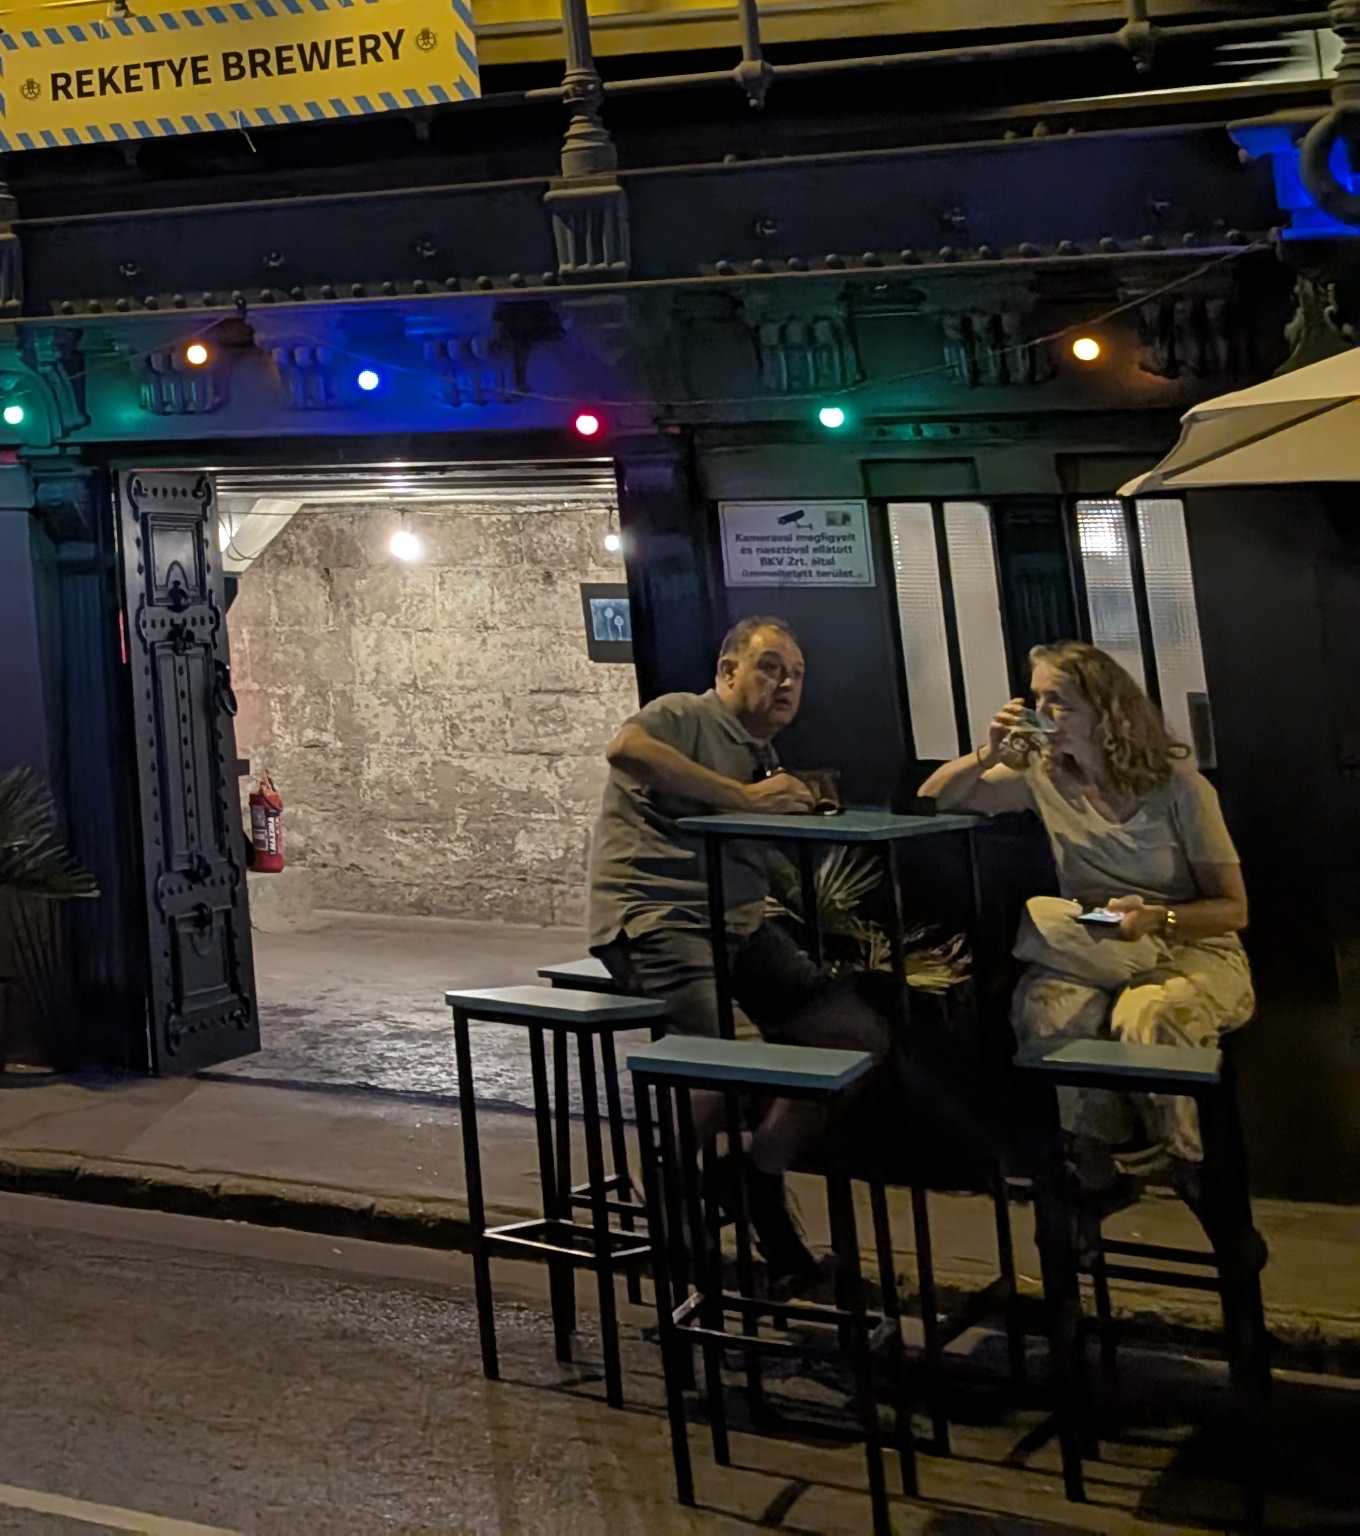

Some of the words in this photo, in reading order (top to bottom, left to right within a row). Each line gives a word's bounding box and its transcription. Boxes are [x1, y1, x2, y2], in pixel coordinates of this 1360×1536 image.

[50, 54, 212, 102] REKETYE
[222, 28, 407, 82] BREWERY
[760, 556, 784, 566] BKV
